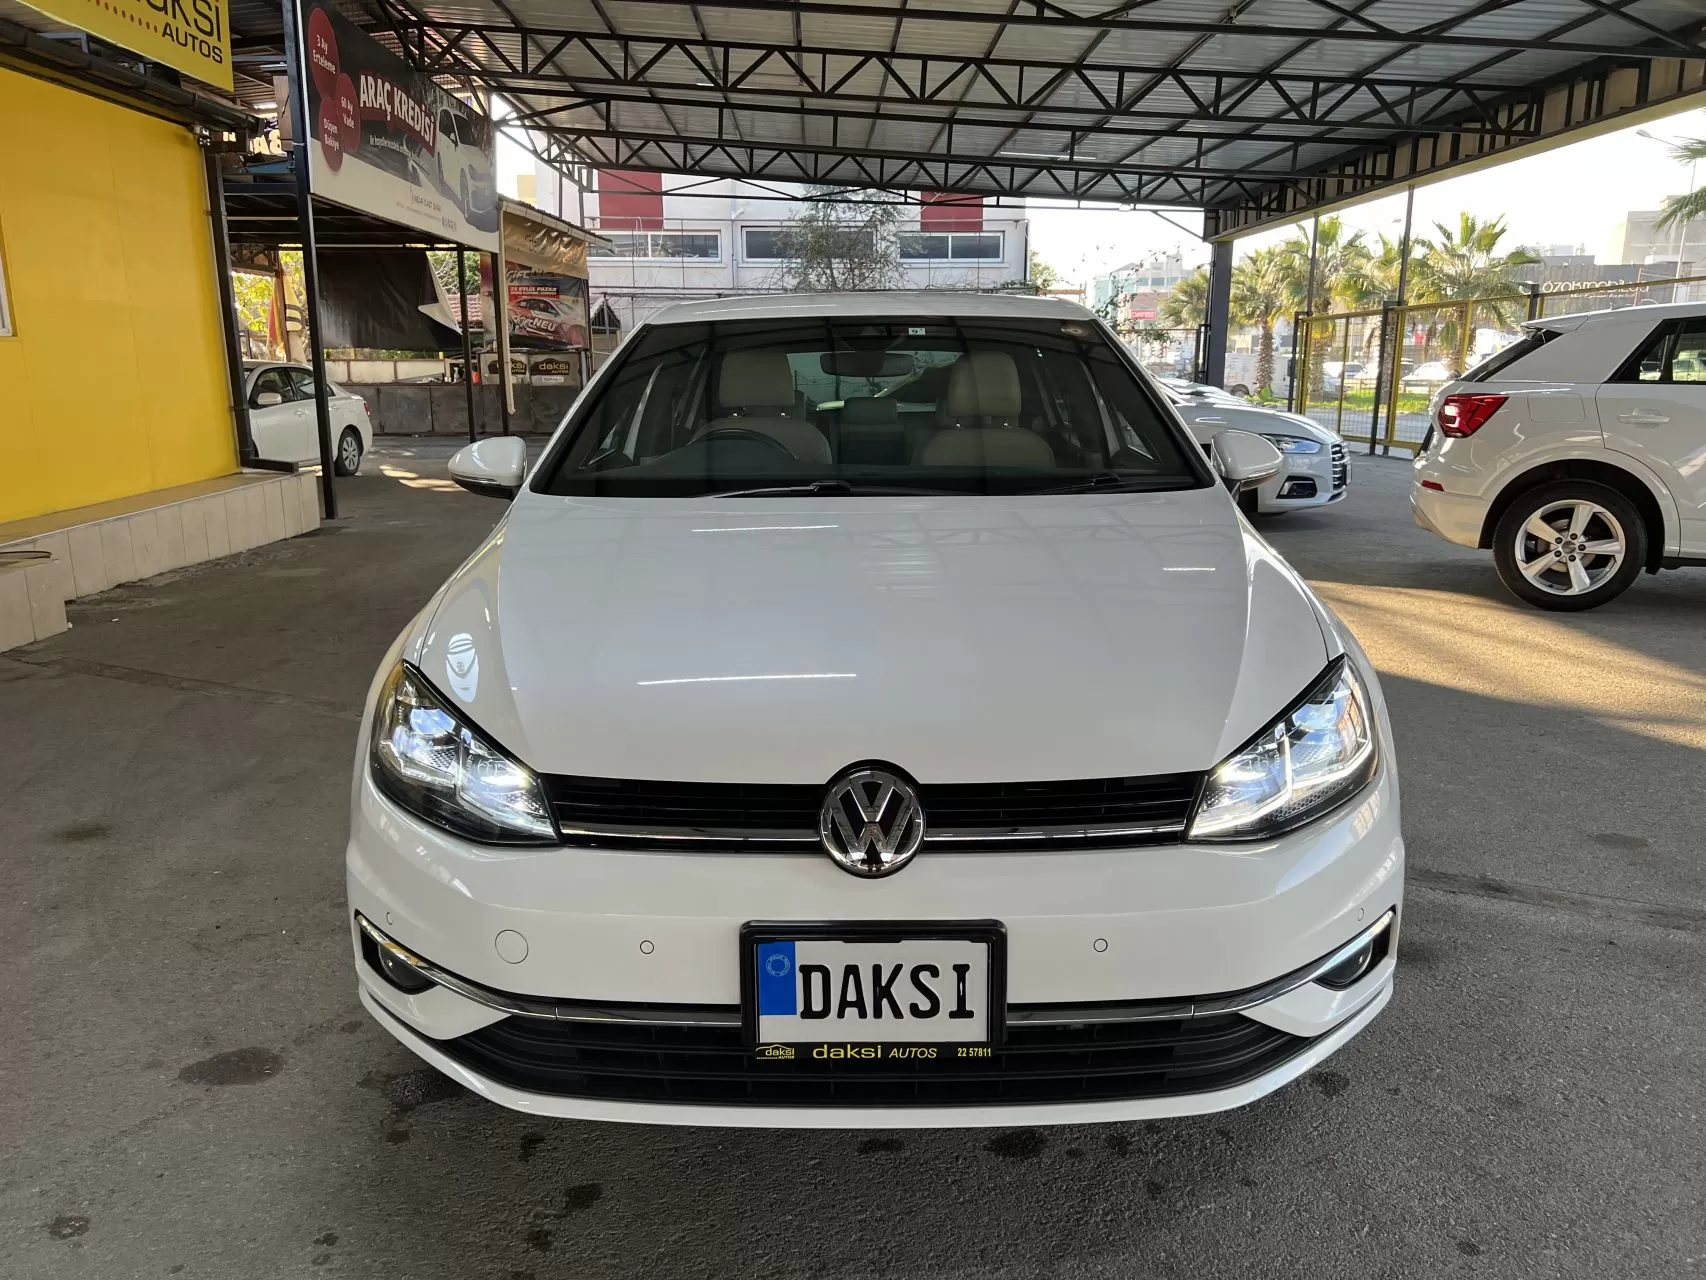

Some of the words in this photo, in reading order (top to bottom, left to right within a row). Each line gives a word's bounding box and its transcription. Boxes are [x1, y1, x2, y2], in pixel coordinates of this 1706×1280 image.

[161, 22, 223, 65] AUTOS
[316, 34, 321, 47] 3
[321, 37, 328, 55] Ay
[360, 75, 392, 121] ARAÇ
[393, 86, 435, 147] KREDİSİ
[538, 361, 568, 370] daksi
[798, 963, 975, 1020] DAKSI
[765, 1047, 795, 1056] daksi
[812, 1044, 882, 1059] daksi
[888, 1048, 938, 1059] AUTOS
[957, 1047, 967, 1057] 22
[968, 1047, 992, 1057] 57811
